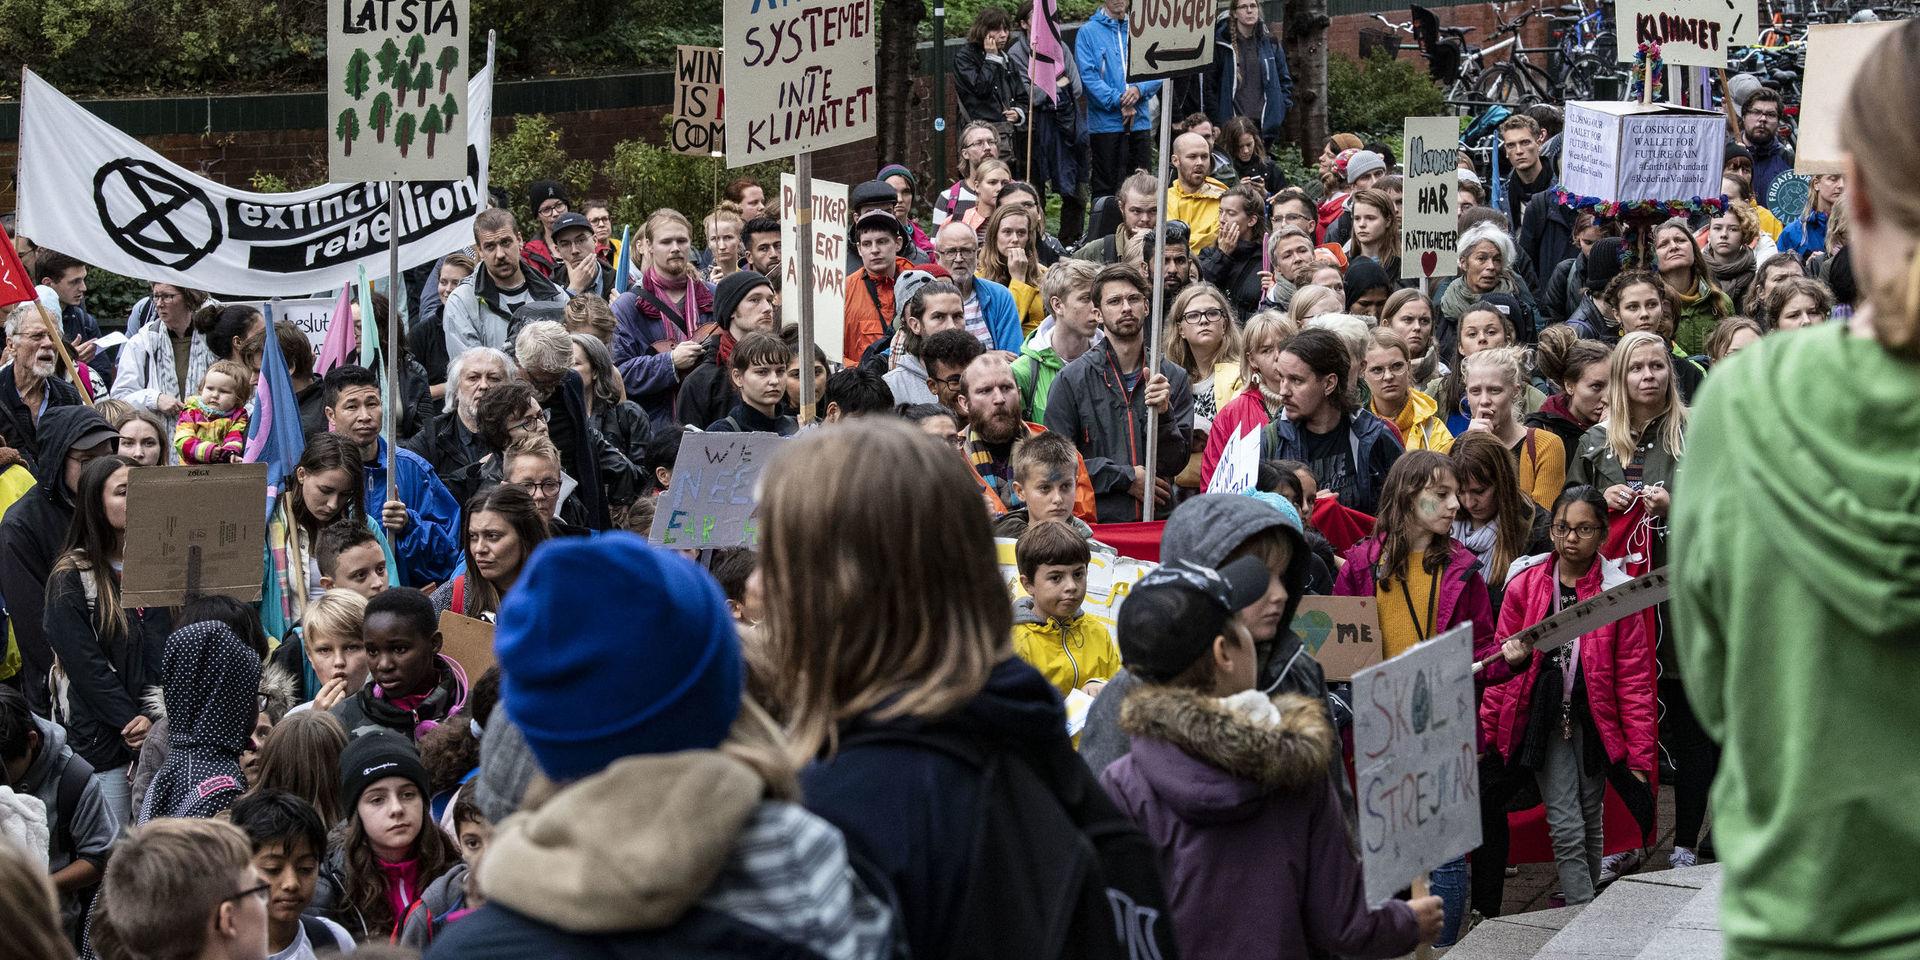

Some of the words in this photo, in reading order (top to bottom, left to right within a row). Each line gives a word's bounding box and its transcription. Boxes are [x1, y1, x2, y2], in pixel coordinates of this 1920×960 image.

[779, 65, 833, 109] INTE
[679, 85, 709, 118] IS
[747, 86, 873, 154] KLIMATET
[1632, 125, 1674, 135] CLOSING
[1676, 125, 1696, 135] OUR
[1634, 137, 1674, 147] WALLET
[1676, 137, 1694, 147] FOR
[1634, 150, 1674, 159] FUTURE
[1674, 150, 1698, 159] GAIN
[1638, 162, 1708, 171] #EarthIsAbundant
[1631, 174, 1705, 183] #RedefineValuable
[1768, 172, 1793, 202] FRIDAYS
[1418, 183, 1449, 214] HAR
[815, 232, 844, 262] ERT
[1405, 229, 1457, 253] RÄTTIGHETER
[1337, 623, 1374, 644] ME
